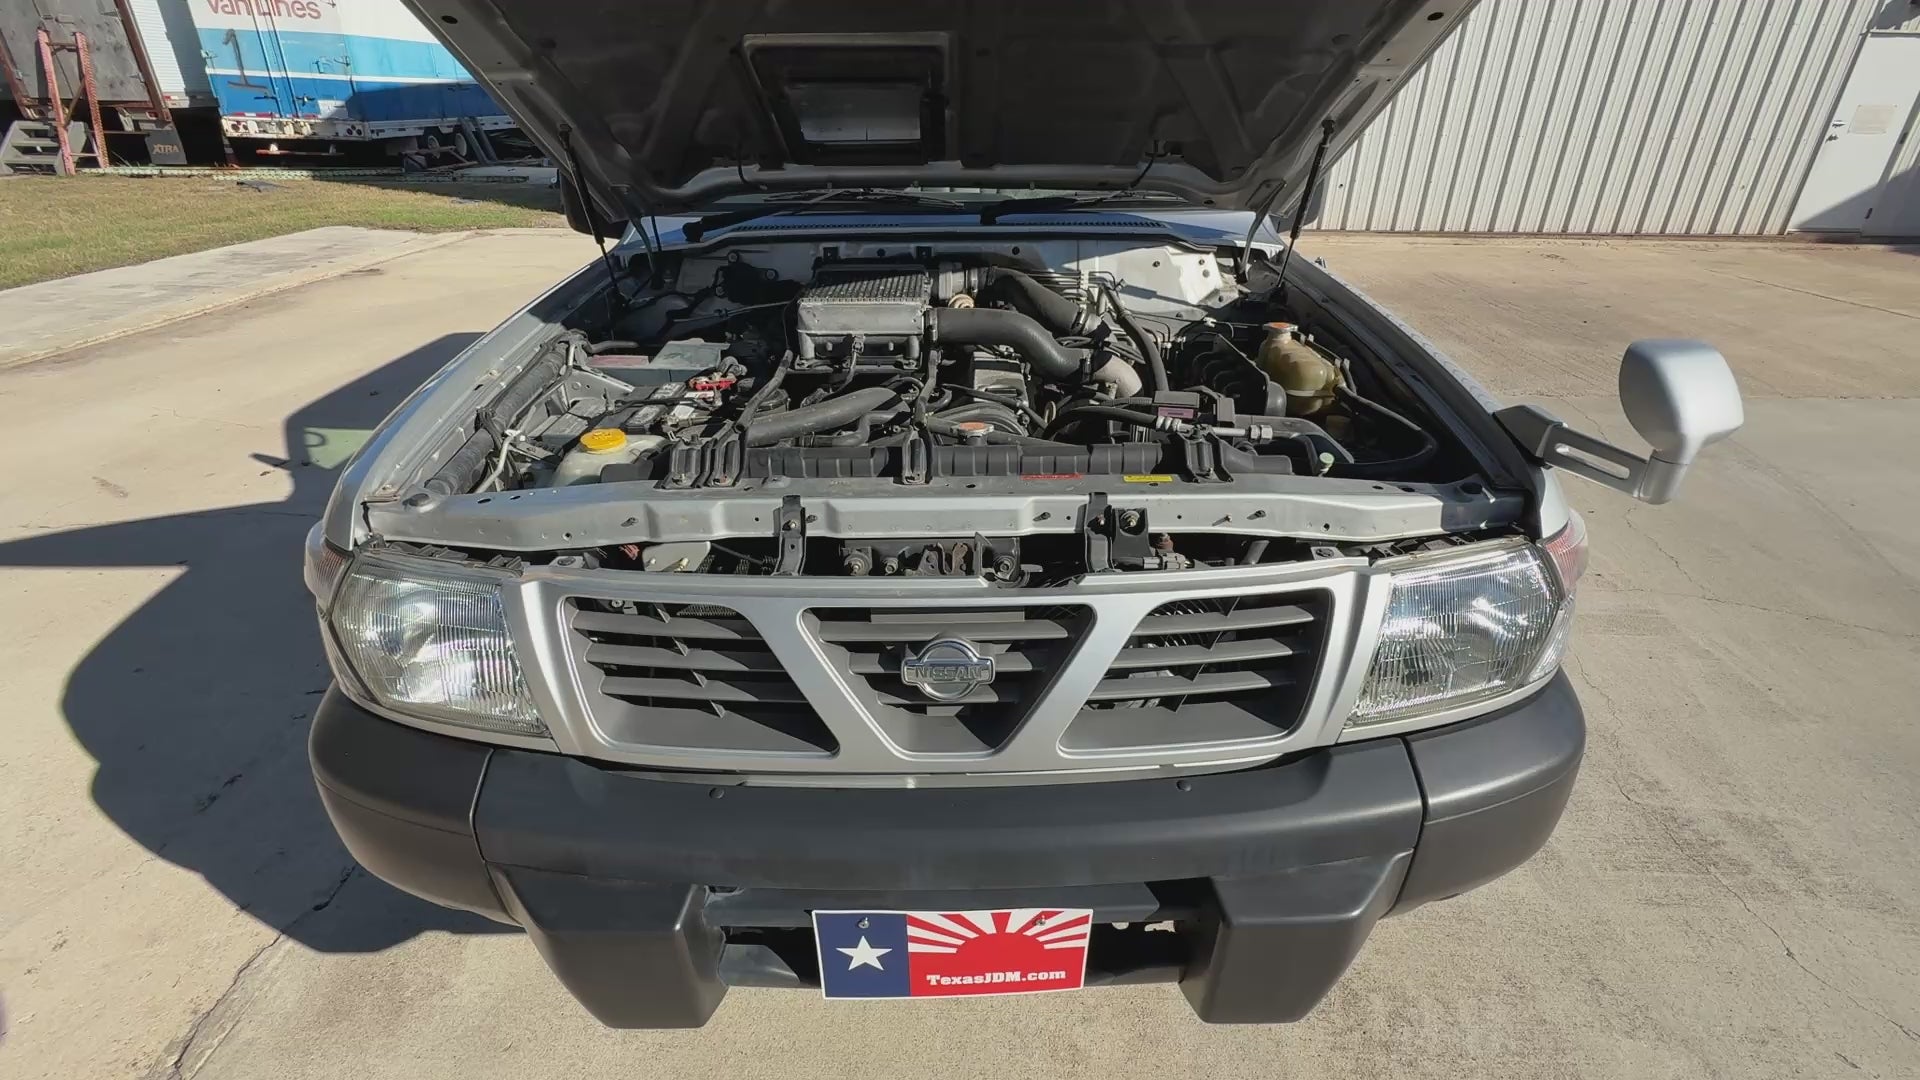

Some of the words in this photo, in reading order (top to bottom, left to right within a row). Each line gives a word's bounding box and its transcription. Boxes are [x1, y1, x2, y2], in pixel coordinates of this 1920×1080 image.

[152, 143, 180, 155] XTRA
[914, 665, 982, 680] NISSAN
[926, 970, 1066, 986] TexasJDM.com
